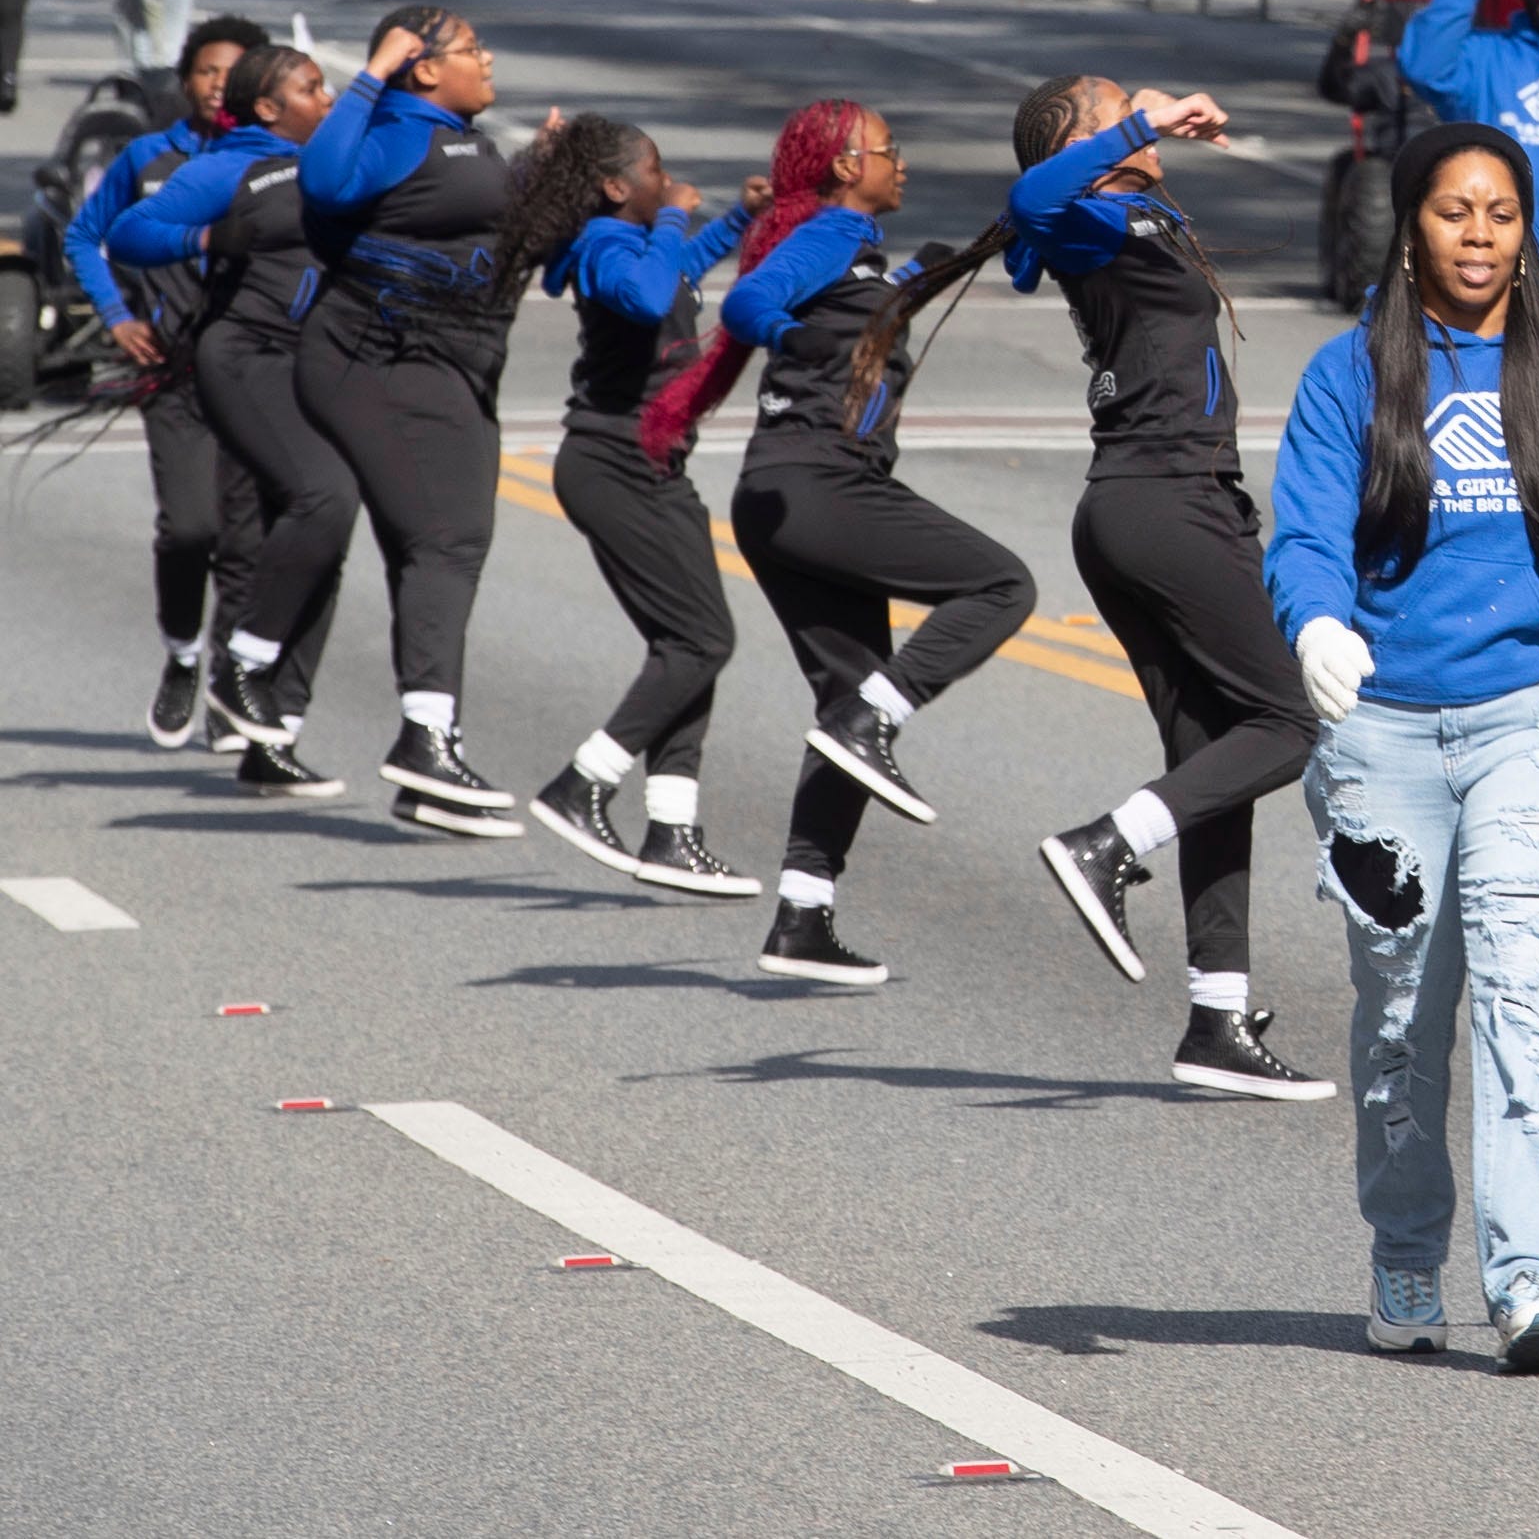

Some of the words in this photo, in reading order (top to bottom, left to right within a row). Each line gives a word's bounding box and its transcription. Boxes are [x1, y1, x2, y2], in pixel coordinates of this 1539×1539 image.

[1432, 479, 1452, 496] &
[1456, 477, 1519, 496] GIRLS
[1442, 498, 1473, 512] THE
[1476, 498, 1504, 512] BIG
